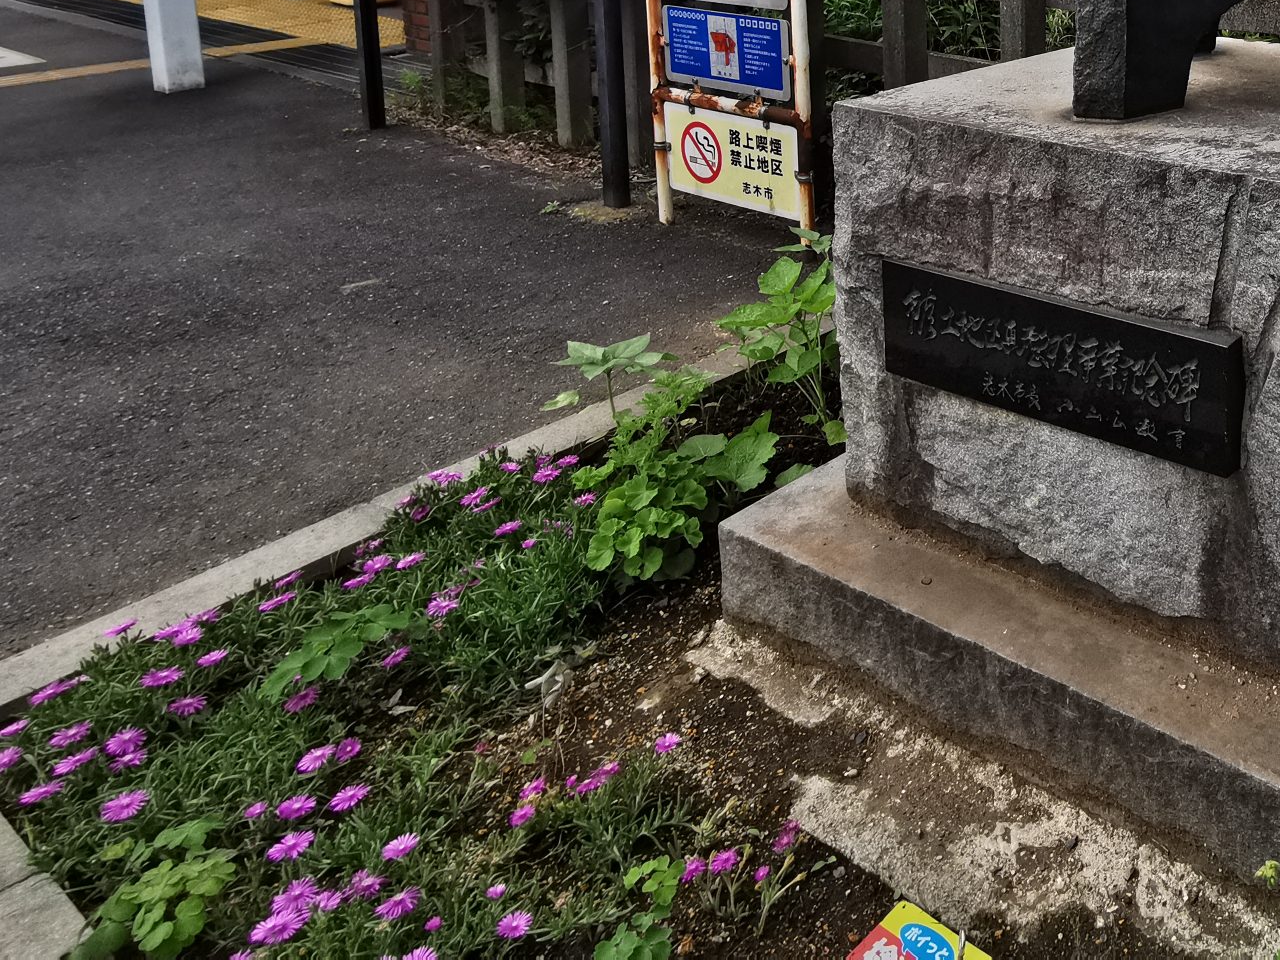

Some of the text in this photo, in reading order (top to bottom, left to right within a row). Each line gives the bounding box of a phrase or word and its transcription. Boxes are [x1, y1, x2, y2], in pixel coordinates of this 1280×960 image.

[729, 129, 783, 157] 路上喫煙
[730, 149, 784, 177] 禁止地区
[742, 182, 774, 200] 志木市
